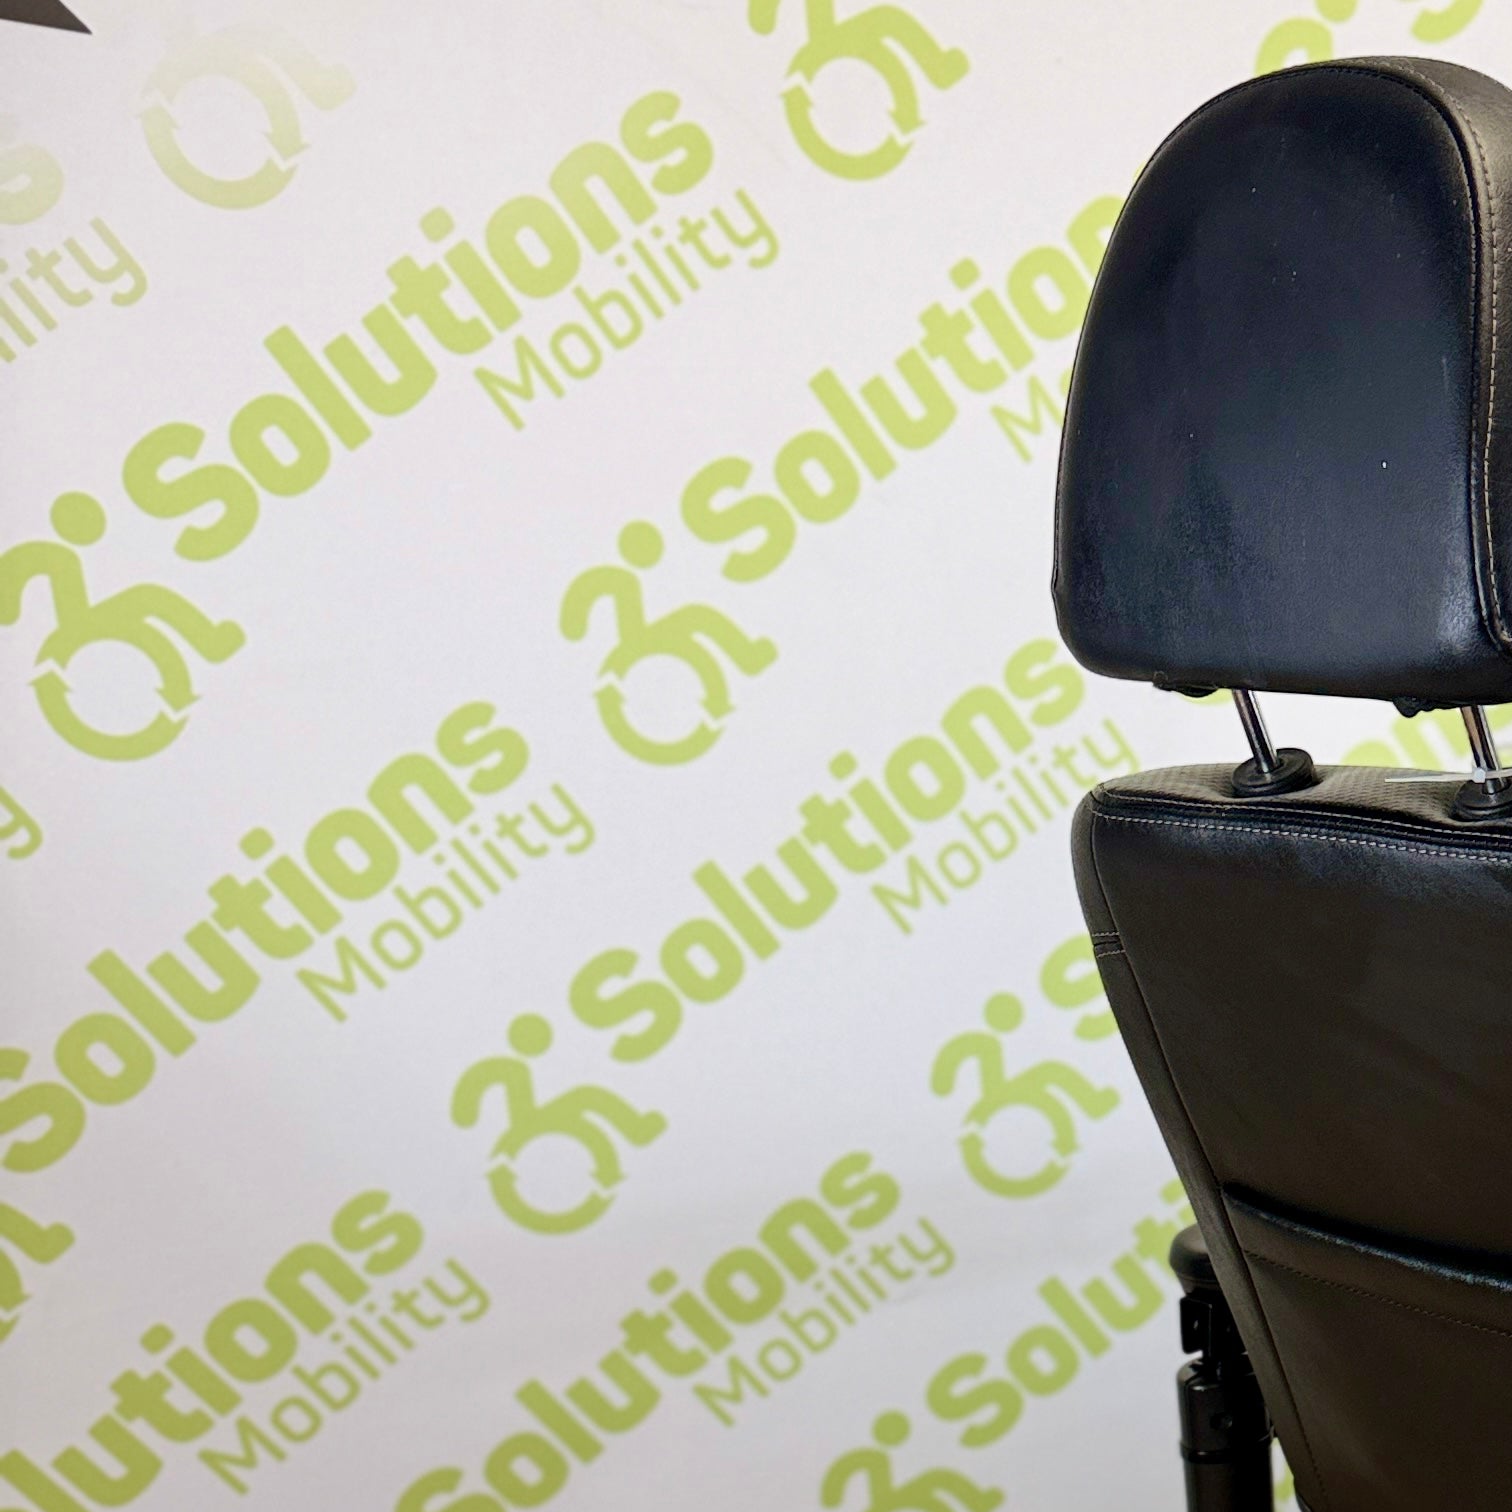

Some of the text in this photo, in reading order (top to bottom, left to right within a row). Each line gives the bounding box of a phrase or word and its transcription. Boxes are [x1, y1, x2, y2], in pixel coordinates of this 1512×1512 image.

[122, 90, 714, 562] Solutions
[472, 188, 780, 432] Mobility
[0, 701, 530, 1174] Solutions
[296, 782, 596, 1023] Mobility
[567, 639, 1086, 1063] Solutions
[870, 717, 1142, 936] Mobility
[198, 1258, 492, 1496] Mobility
[691, 1217, 956, 1428] Mobility
